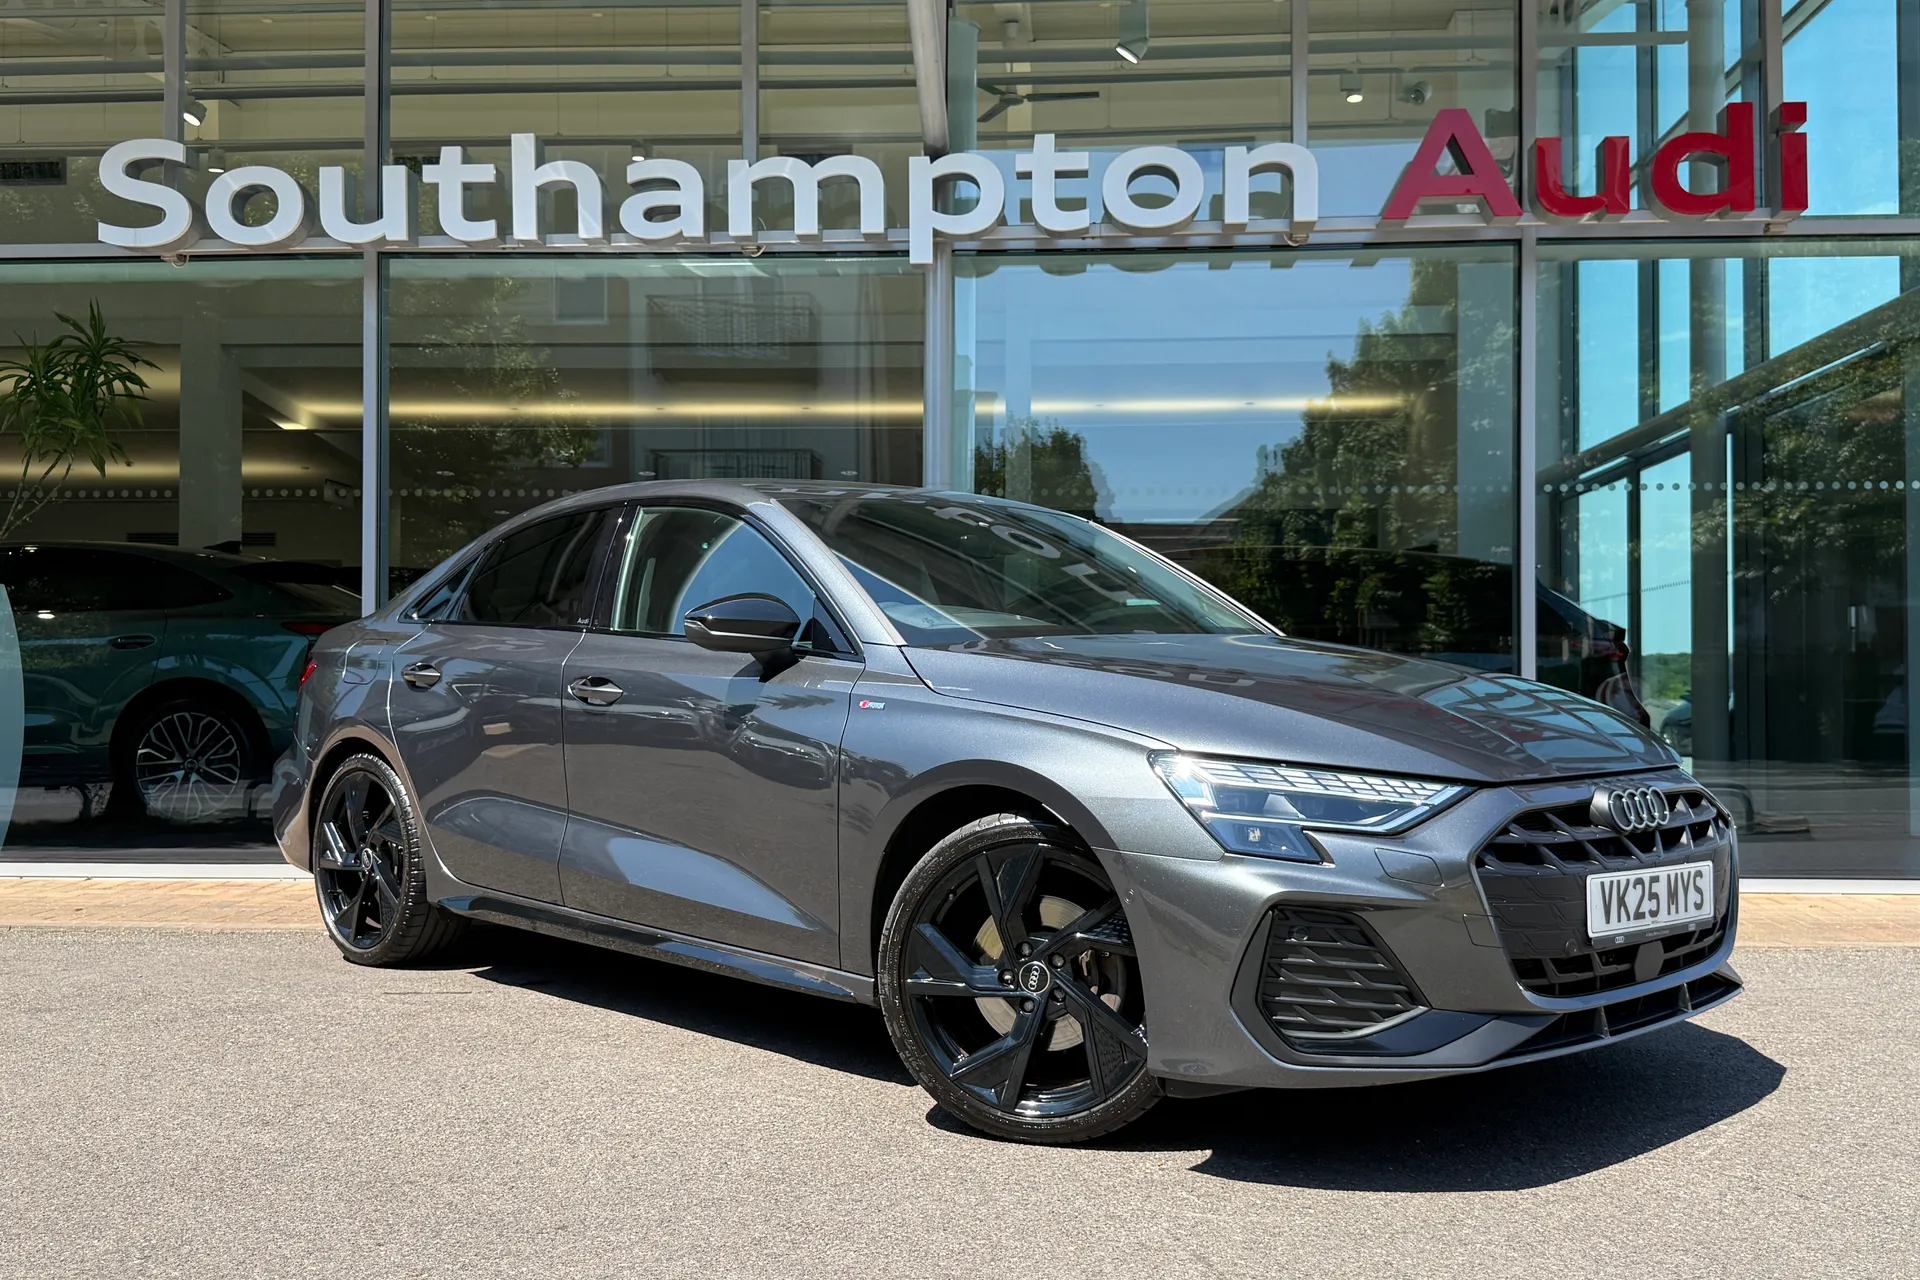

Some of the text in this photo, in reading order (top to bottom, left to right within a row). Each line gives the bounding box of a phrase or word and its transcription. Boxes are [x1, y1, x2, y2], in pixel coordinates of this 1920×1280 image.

[97, 101, 1809, 264] Southampton Audi
[1600, 870, 1704, 925] VK25 MYS
